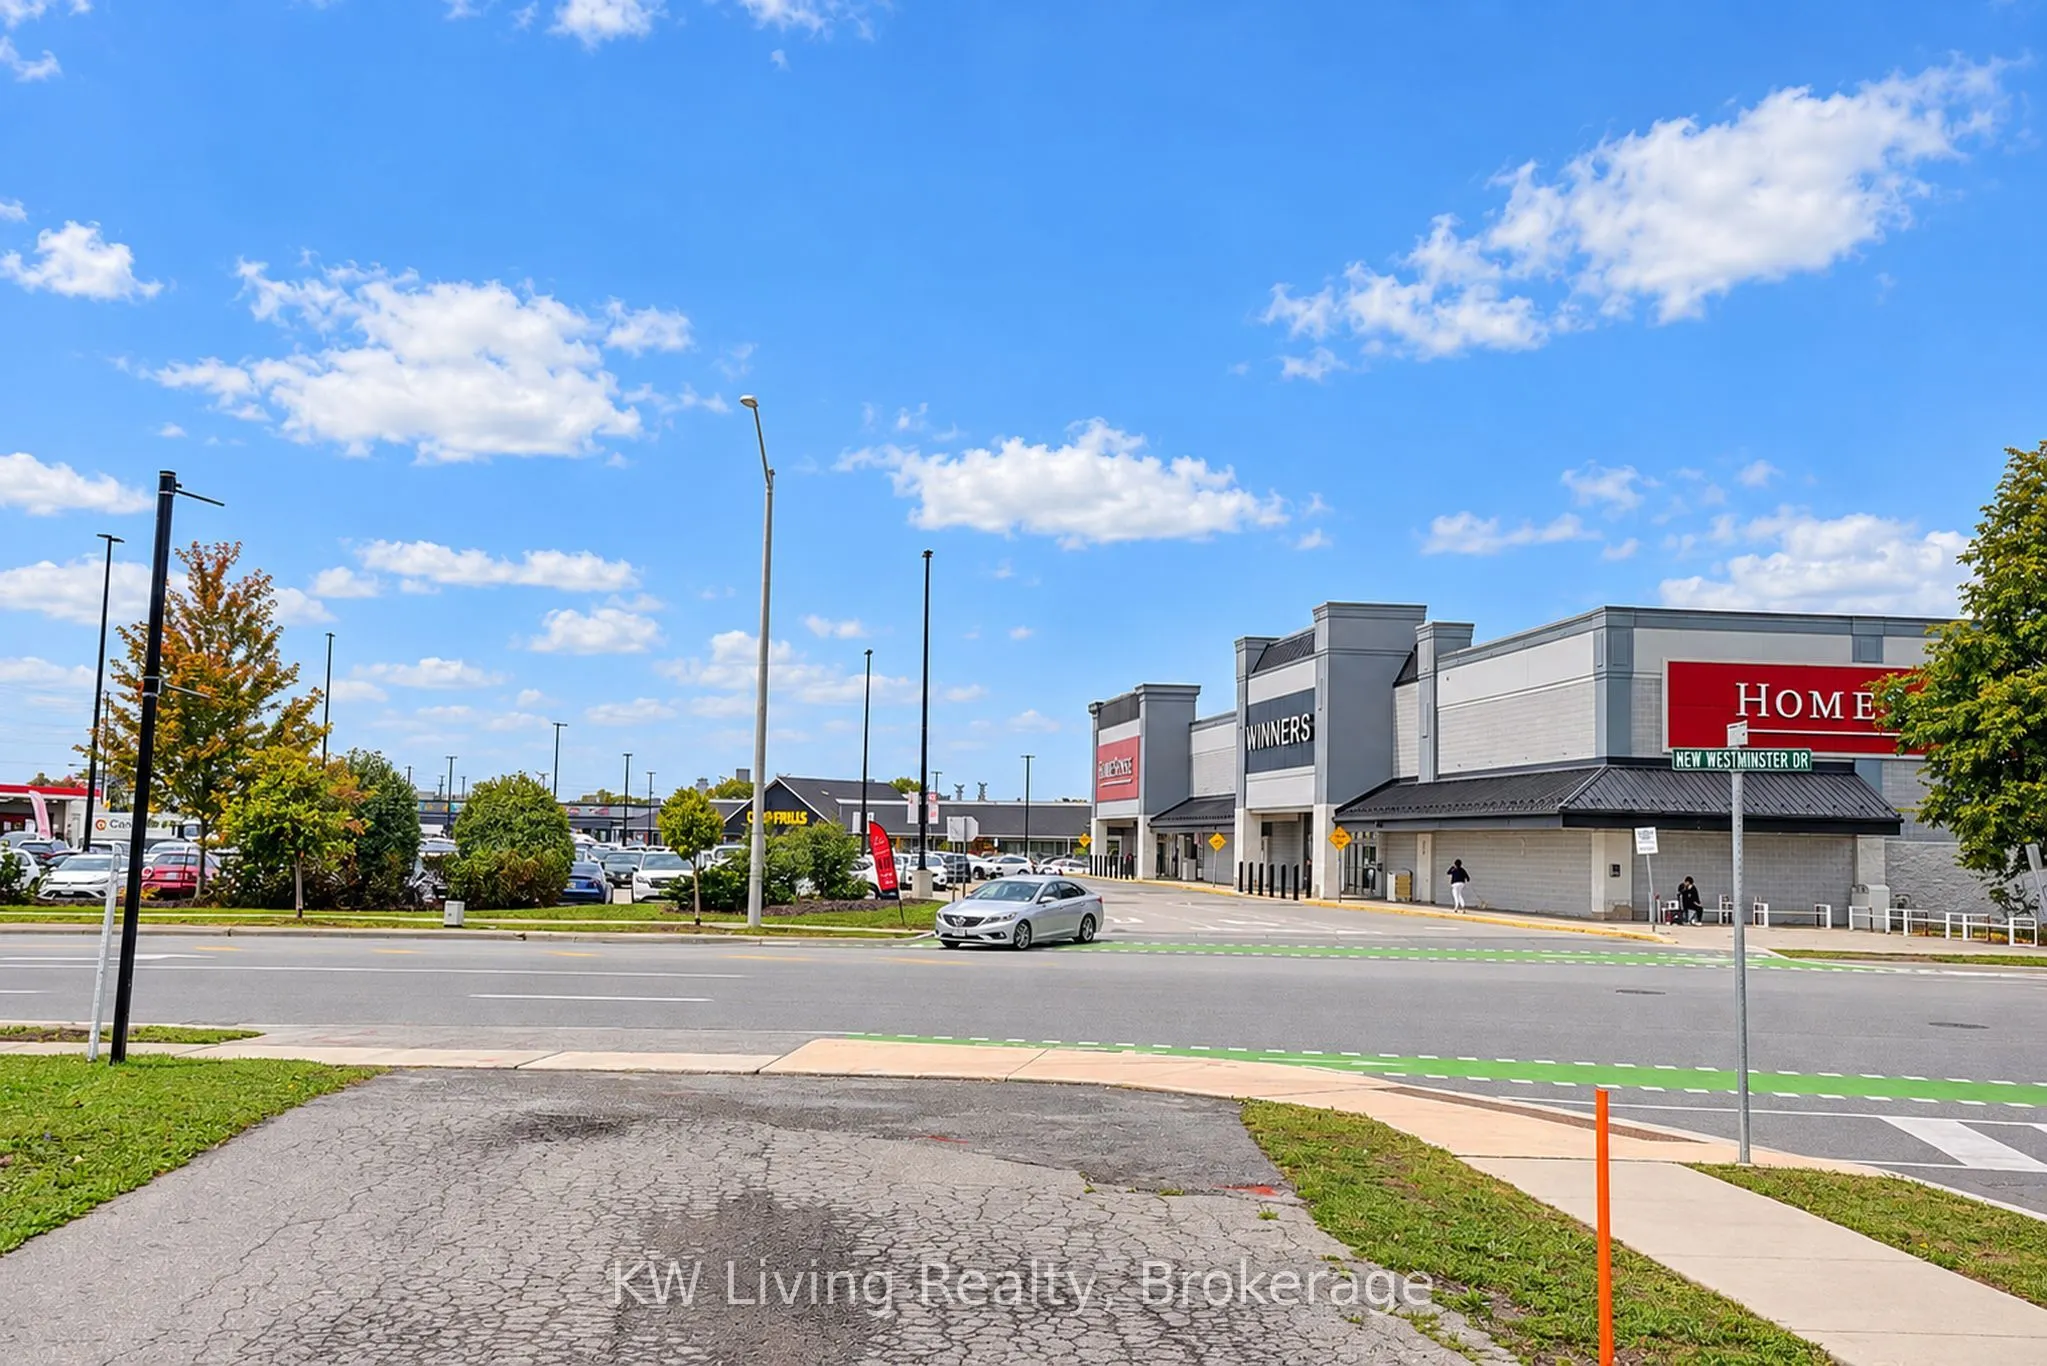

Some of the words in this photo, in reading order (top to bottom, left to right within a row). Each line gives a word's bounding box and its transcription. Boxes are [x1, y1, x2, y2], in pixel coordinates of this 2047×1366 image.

[1246, 713, 1311, 751] WINNERS
[1675, 751, 1701, 769] NEW
[1706, 751, 1789, 769] WESTMINSTER
[1793, 752, 1809, 769] DR
[773, 811, 808, 825] FRILLS
